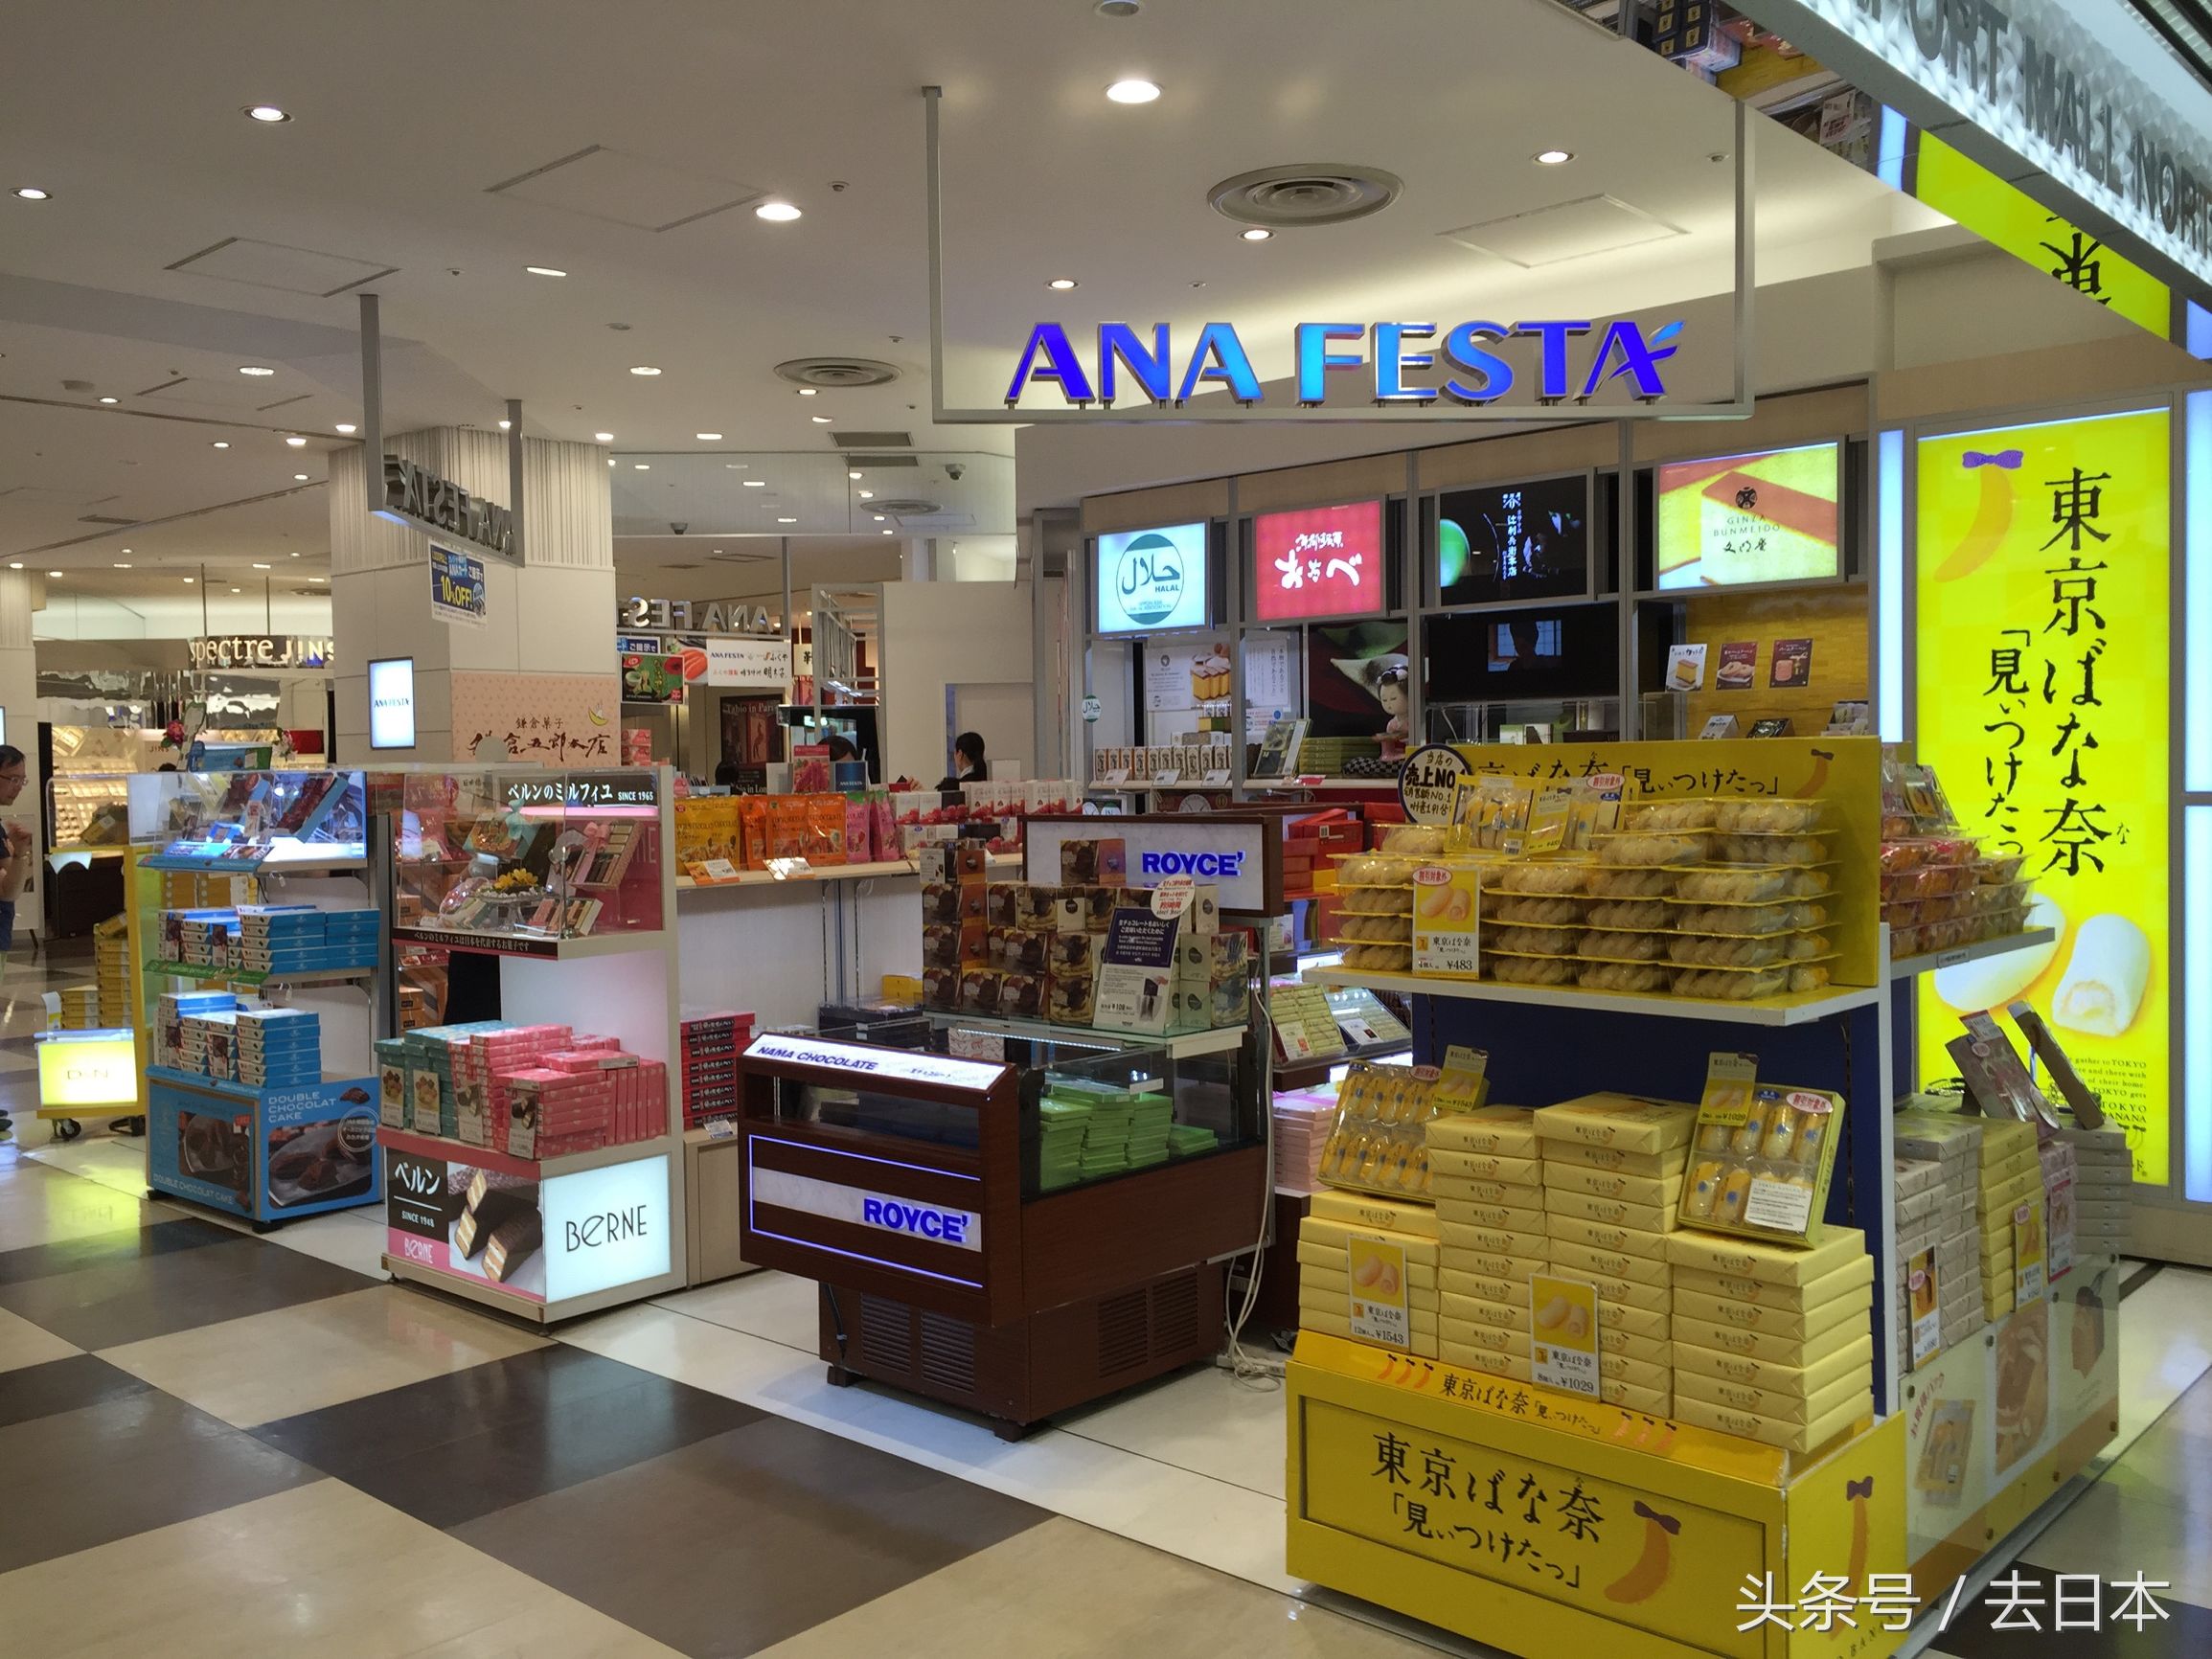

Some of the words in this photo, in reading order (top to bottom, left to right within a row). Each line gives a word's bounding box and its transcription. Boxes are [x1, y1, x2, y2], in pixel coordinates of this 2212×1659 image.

[1007, 321, 1266, 404] ANA
[1296, 318, 1685, 404] FESTA
[1713, 523, 1780, 537] BUNMEIDO
[1122, 553, 1180, 595] حلال
[1154, 584, 1179, 593] HALAL
[191, 636, 274, 670] spectre
[2040, 466, 2112, 876] 東京ばな奈
[508, 783, 613, 802] ベルンのミルフィユ
[617, 791, 636, 801] SINCE
[638, 791, 654, 801] 1965
[1142, 851, 1246, 876] ROYCE'
[1447, 960, 1472, 970] ¥483
[757, 1046, 793, 1058] NAMA
[796, 1052, 878, 1071] CHOCOLATE
[2111, 1058, 2147, 1069] TOKYO
[2129, 1070, 2147, 1079] with
[268, 1091, 321, 1105] DOUBLE
[268, 1098, 336, 1114] CHOCOLAT
[268, 1111, 303, 1124] CAKE
[395, 1162, 440, 1195] ベルン
[401, 1210, 420, 1223] SINCE
[864, 1196, 970, 1243] ROYCE'
[1376, 1329, 1404, 1345] ¥1543
[1561, 1375, 1594, 1394] ¥1029
[1439, 1373, 1530, 1416] 東京ばな奈
[1370, 1431, 1606, 1544] 東京ばな奈
